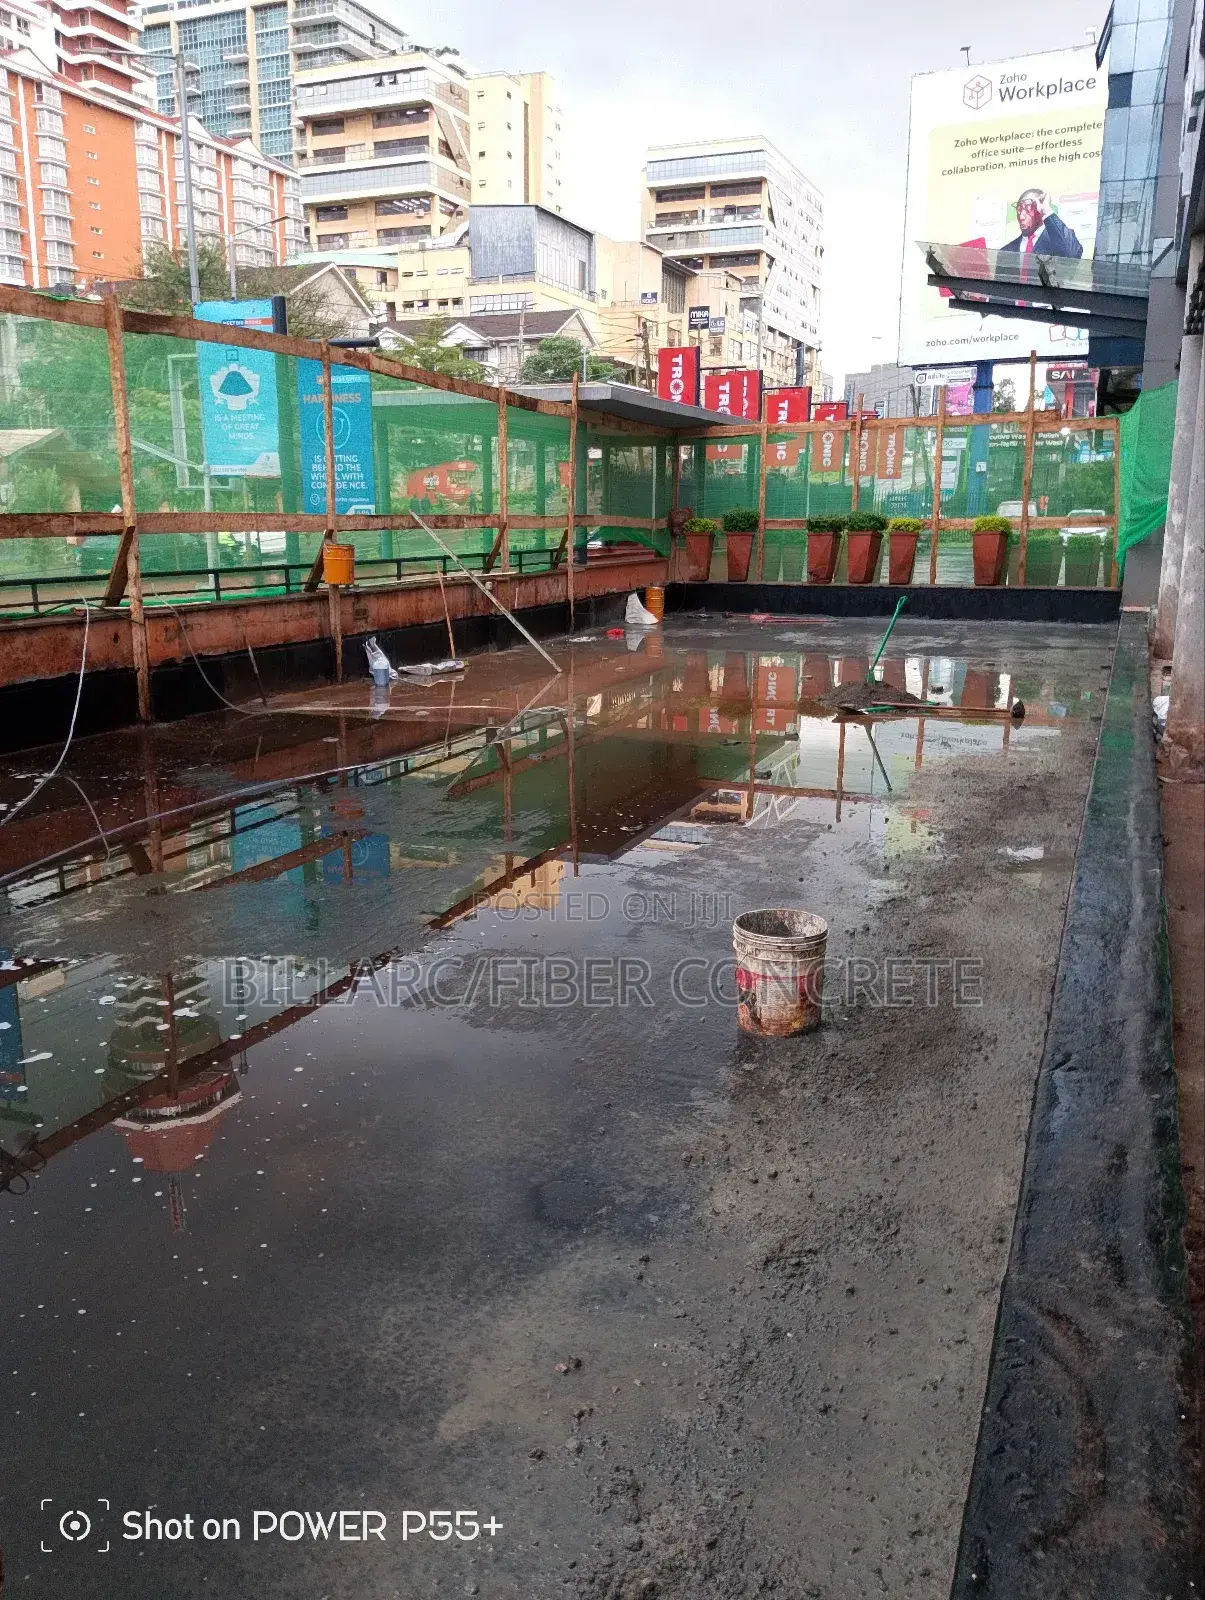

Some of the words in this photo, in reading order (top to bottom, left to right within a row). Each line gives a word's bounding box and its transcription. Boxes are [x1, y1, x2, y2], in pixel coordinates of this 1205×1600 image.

[1000, 73, 1027, 85] Zoho
[999, 75, 1097, 102] Workplace
[954, 137, 978, 148] Zoho
[980, 131, 1035, 145] Workplace:
[1037, 128, 1053, 137] the
[1055, 121, 1102, 135] complete
[971, 148, 999, 159] office
[942, 162, 1007, 176] collaboration,
[1009, 158, 1039, 168] minus
[1040, 154, 1057, 164] the
[1059, 151, 1081, 162] high
[1082, 150, 1103, 159] cos
[925, 332, 1019, 347] zoho.com/workplace
[231, 413, 265, 421] MEETING
